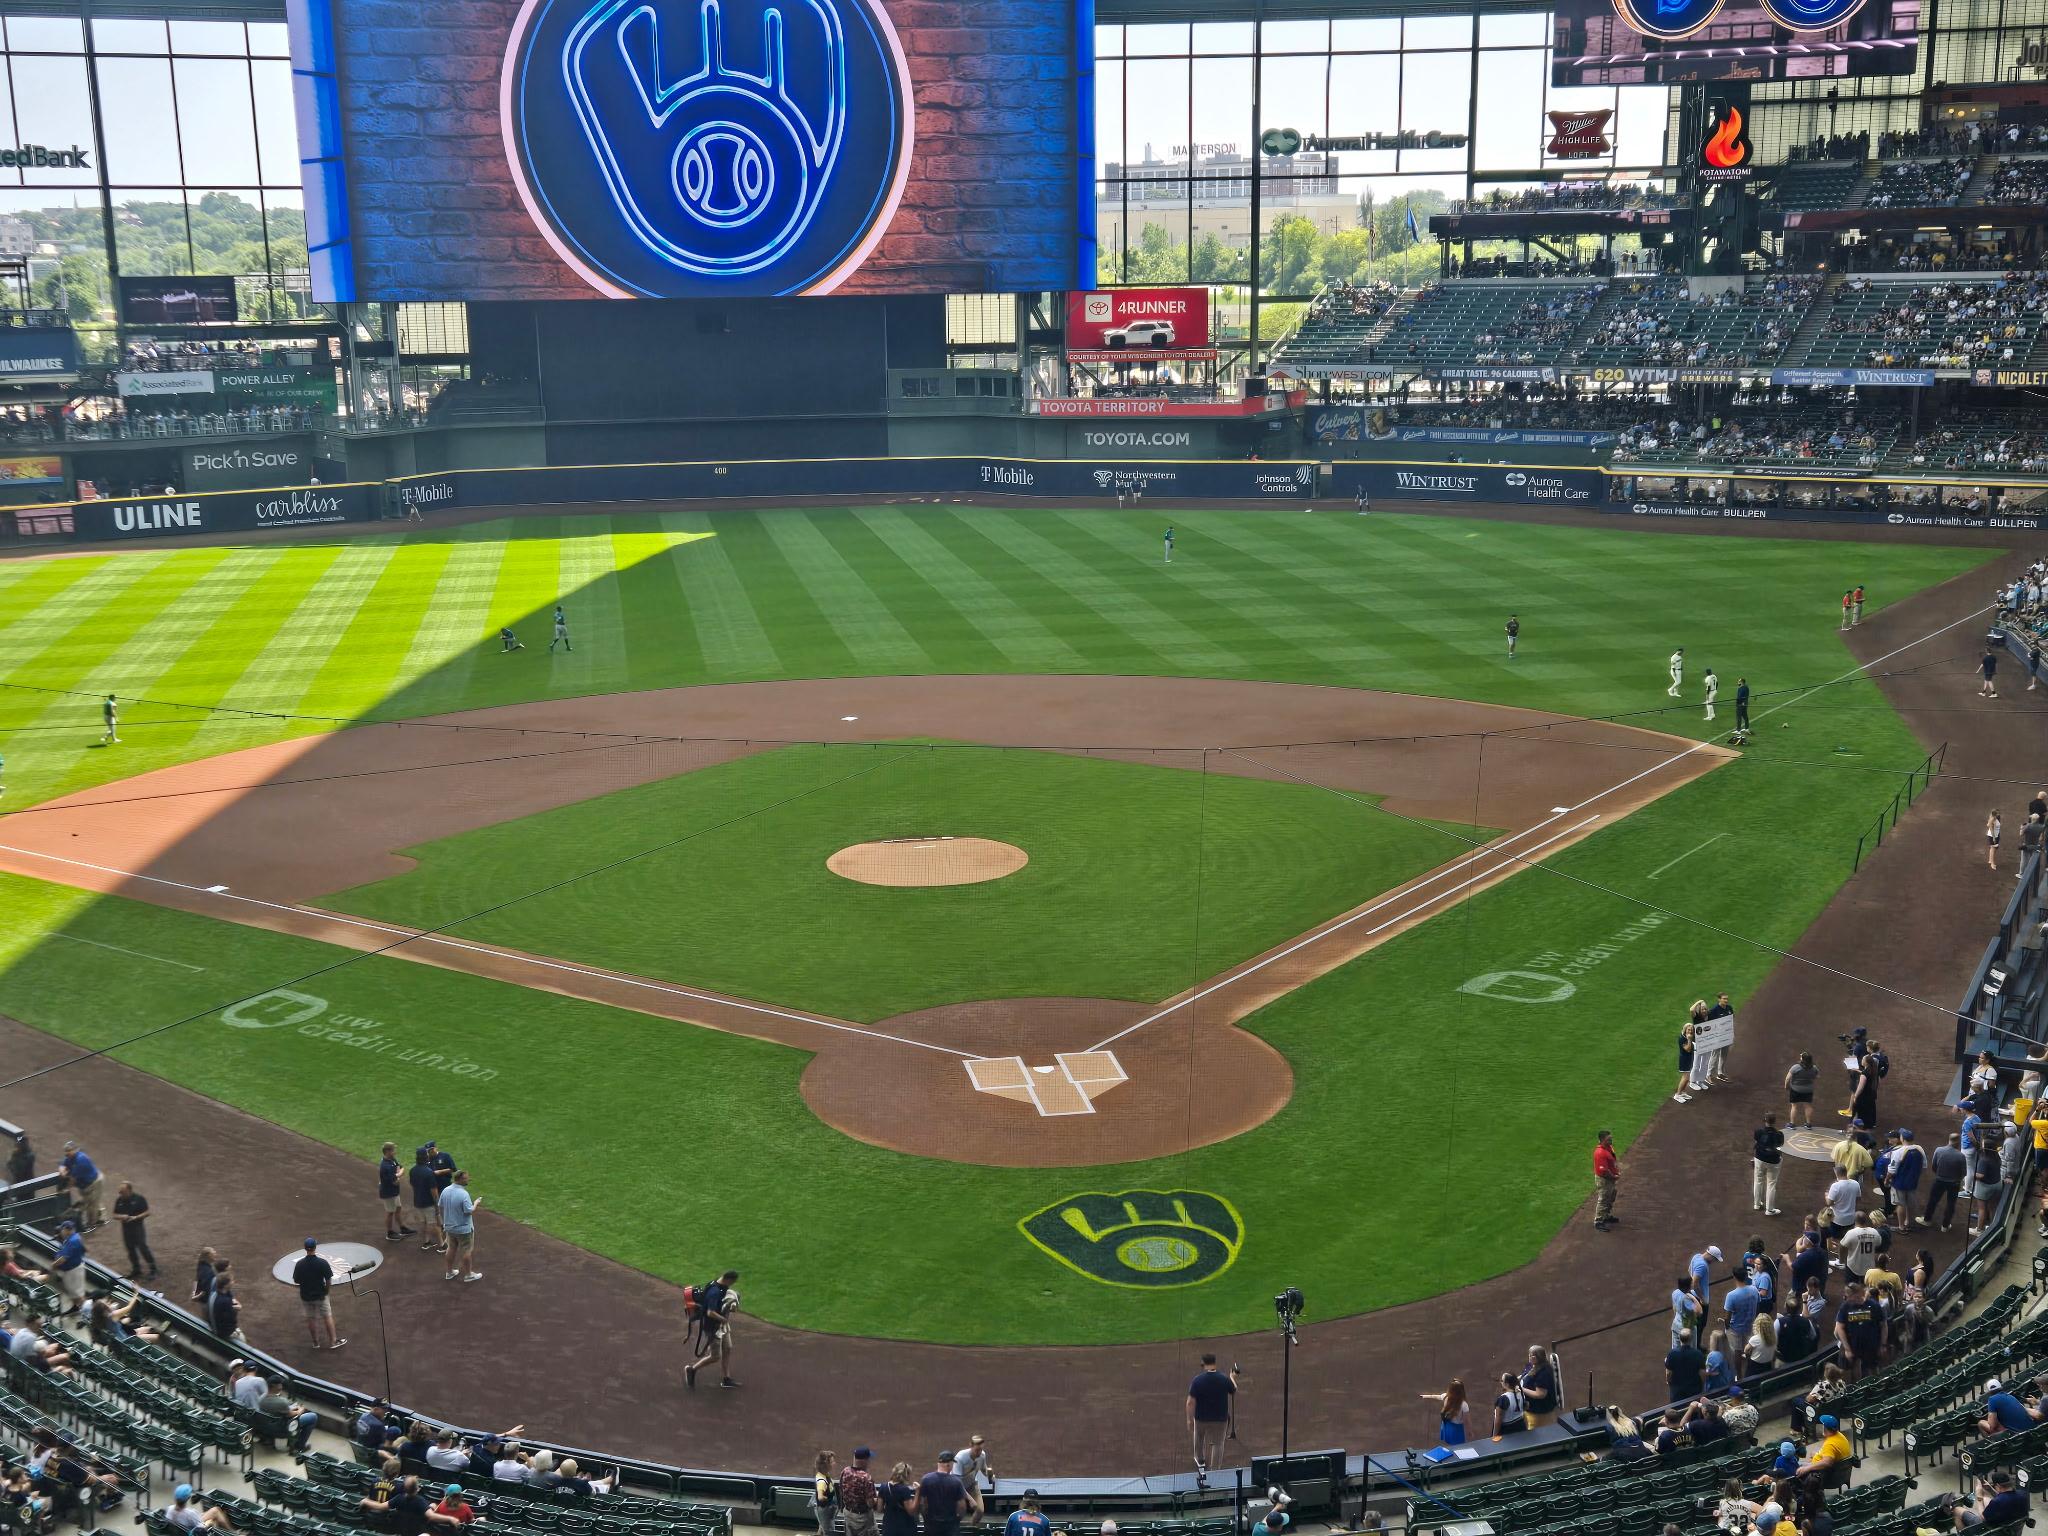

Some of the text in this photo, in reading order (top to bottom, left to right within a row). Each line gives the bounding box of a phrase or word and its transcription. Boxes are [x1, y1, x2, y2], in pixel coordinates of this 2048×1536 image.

[1563, 117, 1598, 134] Miller
[1306, 129, 1467, 150] Aurora Health Care
[1558, 135, 1600, 145] HIGH LIFE
[1172, 143, 1236, 156] MATERSON
[1117, 301, 1187, 314] 4RUNNER
[0, 359, 64, 371] ILWAUKEE
[221, 374, 295, 386] POWER ALLEY
[1441, 369, 1465, 378] GREAT
[1466, 369, 1490, 377] TASTE.
[1491, 369, 1501, 377] 96
[1502, 369, 1541, 378] CALORIES.
[1594, 368, 1678, 382] 620 WTMJ
[1856, 370, 1926, 383] WINTRUST
[1998, 371, 2048, 385] NICOLET
[1043, 401, 1165, 413] TOYOTA TERRITORY
[1315, 411, 1361, 433] Culver's
[1085, 432, 1190, 447] TOYOTA.COM
[192, 454, 232, 471] Pick
[252, 453, 297, 467] Save
[714, 467, 727, 475] 400
[1115, 471, 1177, 479] Northwestern
[1255, 474, 1291, 483] Johnson
[1396, 472, 1476, 489] WINTRUST
[1527, 476, 1563, 487] Aurora
[1261, 483, 1297, 492] Controls
[1527, 486, 1590, 499] Health Care
[256, 491, 343, 519] carbliss
[113, 502, 202, 531] ULINE
[1649, 506, 1766, 518] Aurora Health Care BULLPEN
[1905, 516, 2038, 528] Aurora Health Care BULLPEN
[330, 1014, 385, 1029] uw
[298, 1024, 499, 1081] credit union
[1860, 1241, 1873, 1254] 10
